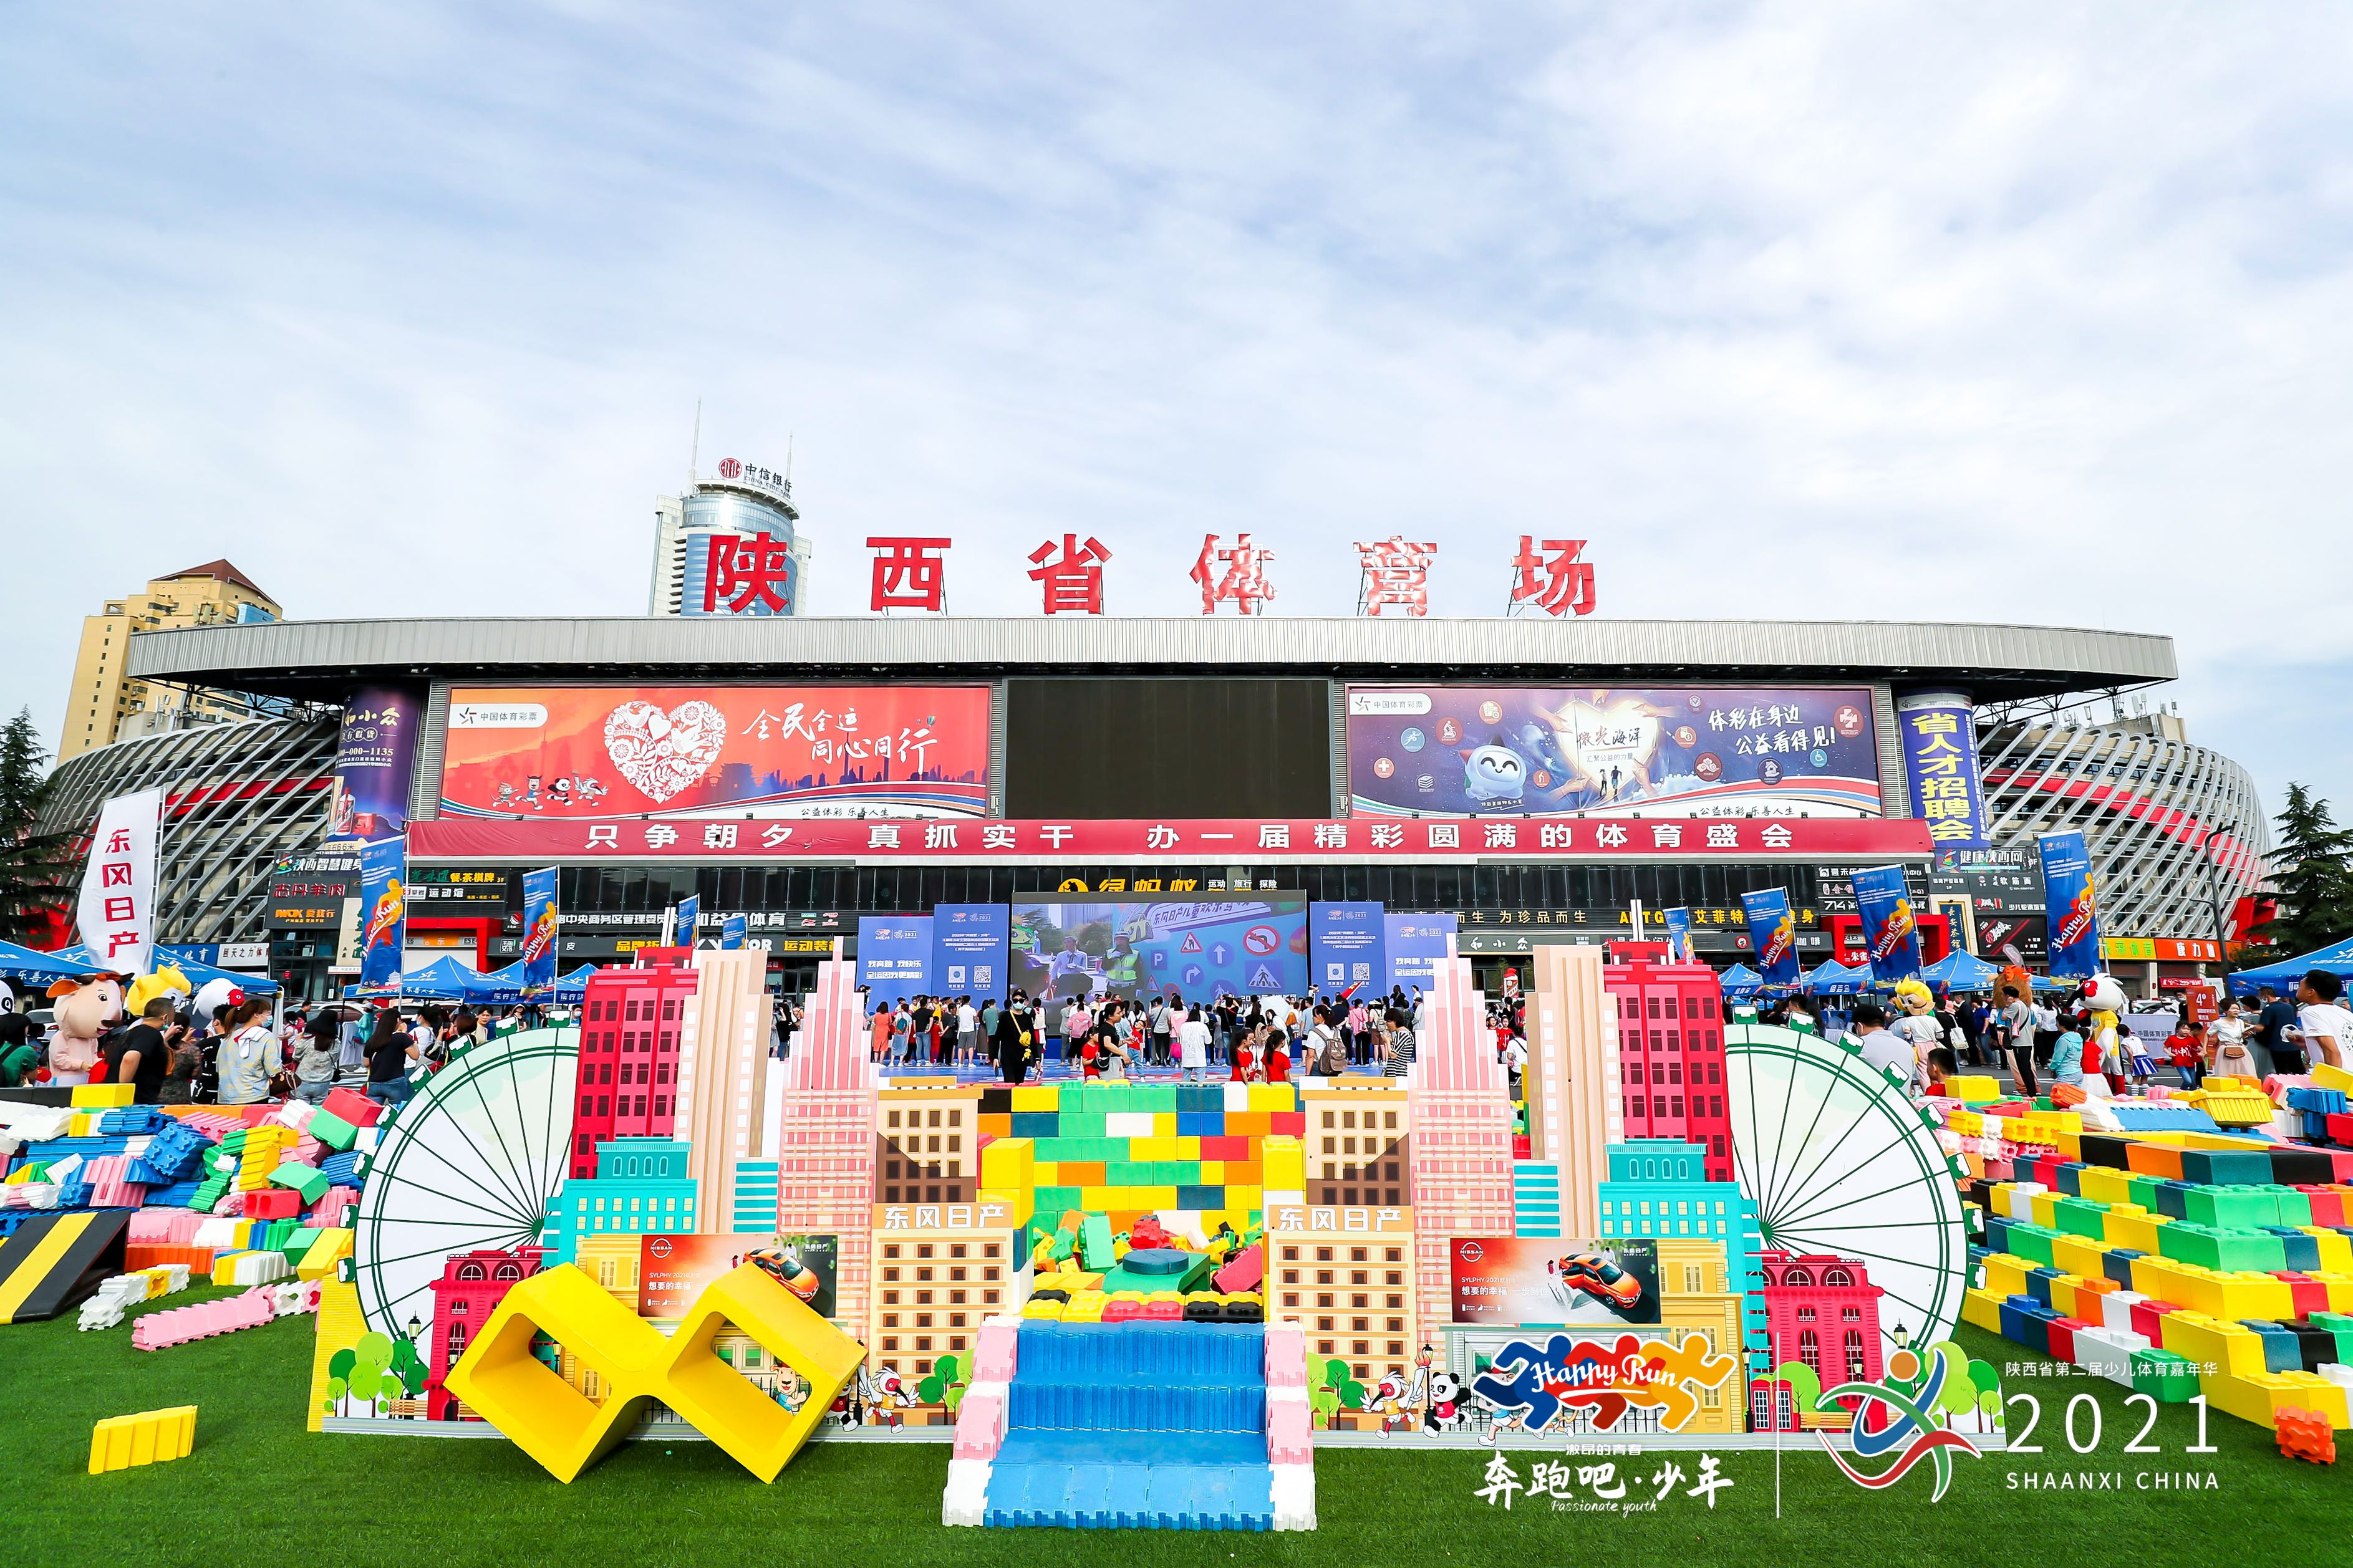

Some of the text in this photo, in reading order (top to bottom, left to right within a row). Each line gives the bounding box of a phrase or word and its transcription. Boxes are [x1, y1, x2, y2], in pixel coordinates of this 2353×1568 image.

[745, 463, 793, 493] 中信银行
[703, 532, 1597, 616] 陕西省体育场
[1374, 700, 1423, 709] 中国体育彩票
[480, 712, 537, 721] 中国体育彩票
[741, 702, 858, 742] 全民全运
[1708, 705, 1804, 733] 体彩在身边
[1578, 725, 1641, 749] 微光海洋
[811, 728, 938, 776] 同心同行
[1587, 753, 1633, 762] 汇聚公益的力量
[1911, 712, 1974, 841] 省人才招聘会
[801, 807, 889, 817] 公益体彩 乐善人生
[1700, 807, 1794, 817] 公益体彩 乐善人生
[584, 823, 1794, 849] 只争朝夕 真抓实干 办一届精彩圆满的体育盛会
[1960, 850, 2023, 864] 健康陕西网
[102, 829, 139, 958] 东风日产
[273, 883, 345, 898] 志丹羊肉
[428, 888, 464, 898] 运动馆
[1208, 879, 1226, 888] 运动
[1234, 879, 1252, 888] 旅行
[1260, 879, 1278, 888] 探险
[375, 900, 399, 922] Run
[1500, 910, 1587, 923] 为珍品而生
[1774, 930, 1790, 945] Run
[1871, 932, 1895, 963] Happy
[1888, 915, 1910, 933] Run
[2052, 913, 2084, 953] Happy
[884, 1204, 1003, 1229] 东风日产
[1278, 1207, 1401, 1231] 东风日产
[649, 1281, 692, 1291] 想要的幸福
[1461, 1286, 1549, 1296] 想要的幸福 一步到位
